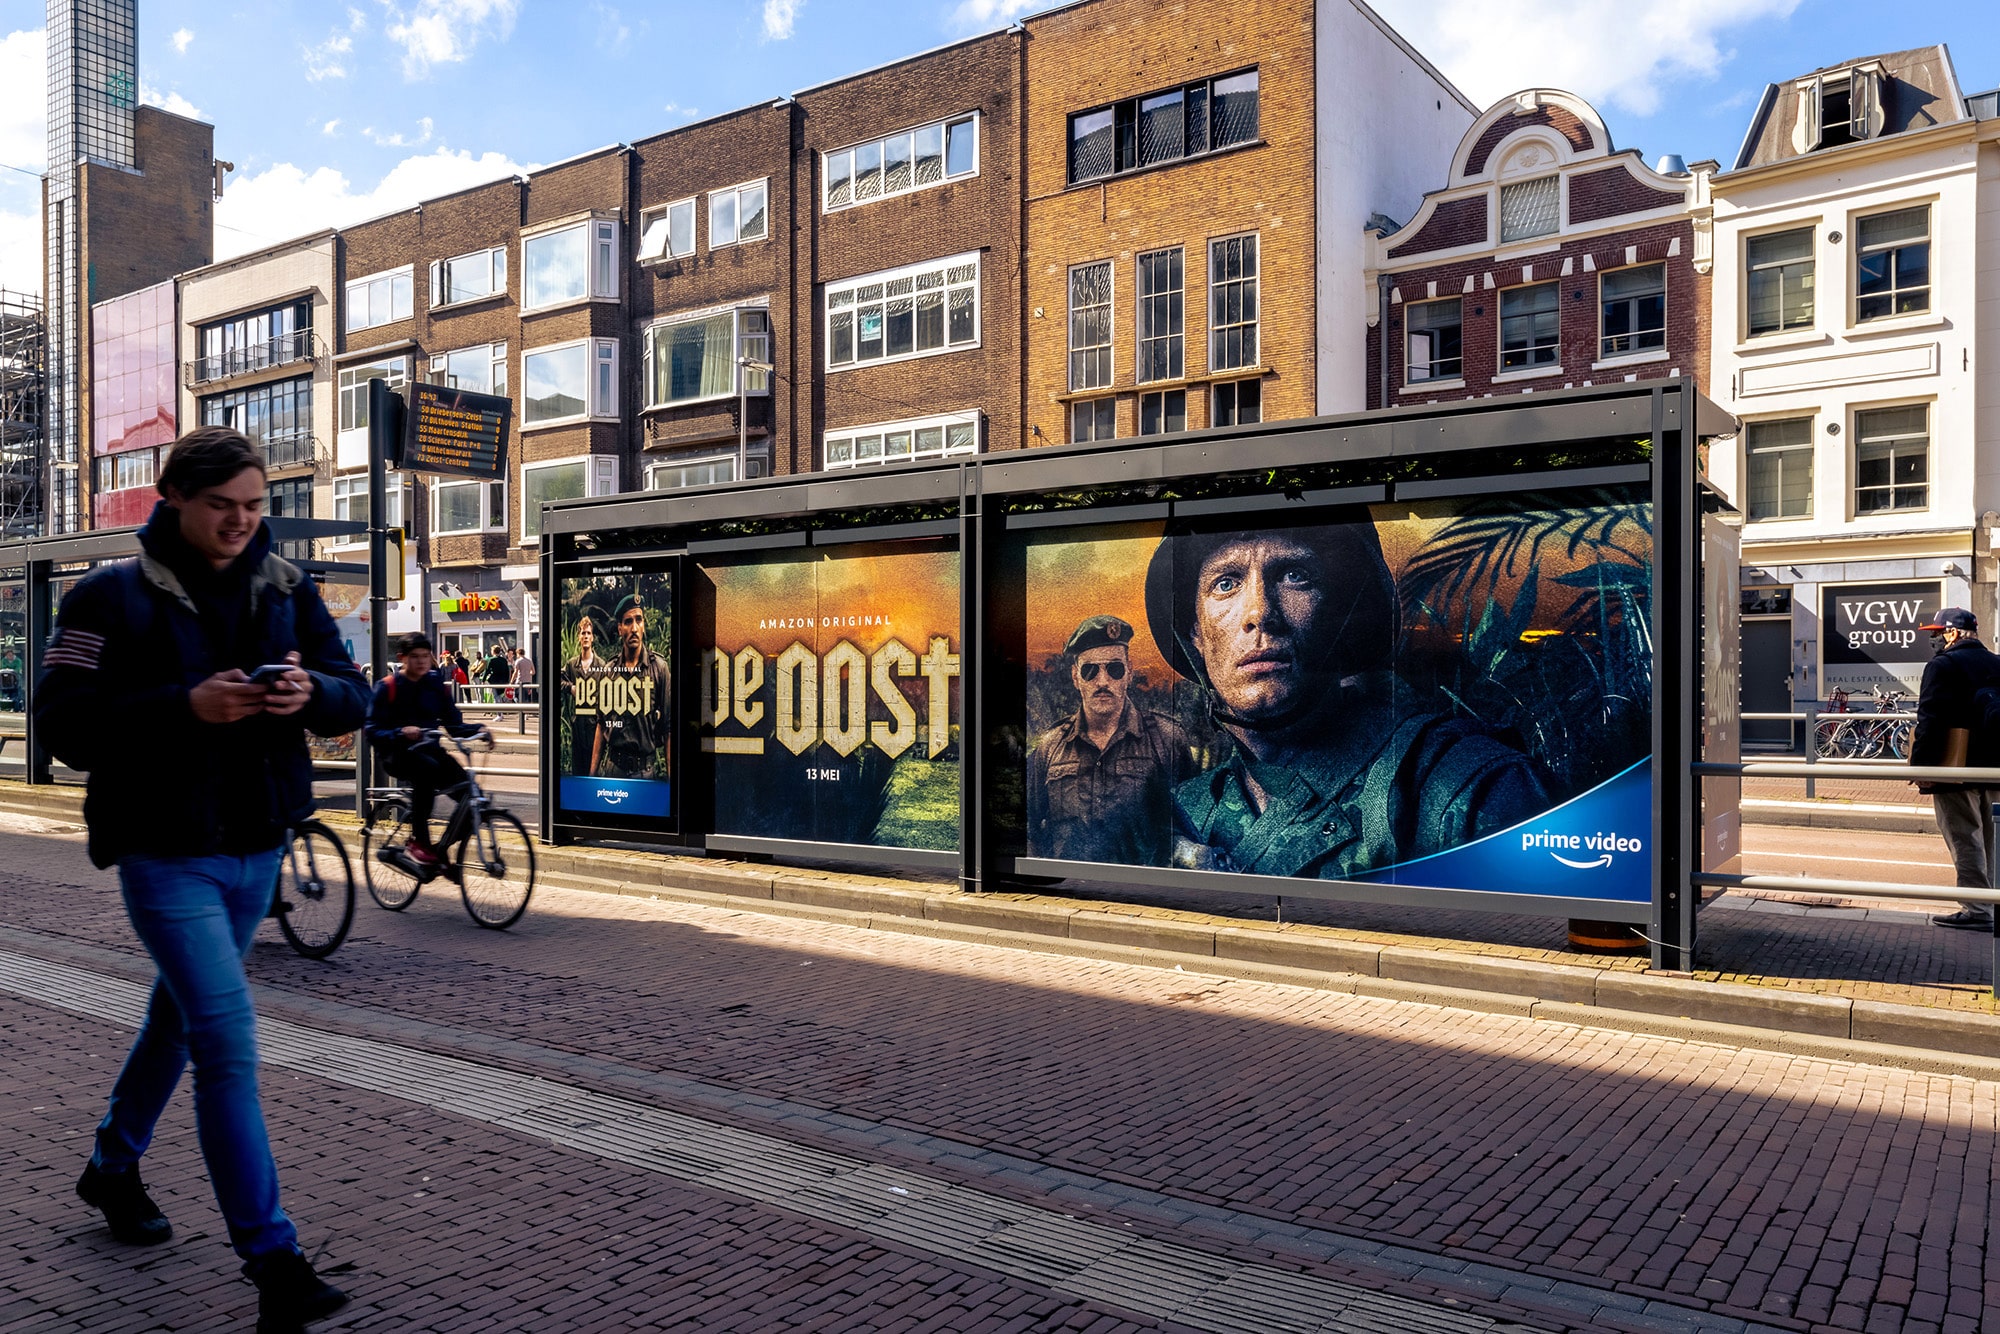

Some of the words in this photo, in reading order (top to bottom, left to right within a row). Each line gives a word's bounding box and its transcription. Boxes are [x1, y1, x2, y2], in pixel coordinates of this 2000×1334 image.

[421, 405, 429, 413] 50
[430, 406, 482, 421] Driebergen-Zeist
[420, 425, 427, 433] 55
[429, 416, 459, 427] Bilthoven
[461, 421, 483, 431] Station
[427, 435, 451, 445] Science
[453, 439, 467, 448] Park
[426, 455, 469, 467] Zeist-Centrum
[1841, 600, 1923, 625] VGW
[760, 617, 814, 630] AMAZON
[822, 614, 891, 628] ORIGINAL
[1848, 629, 1916, 649] group
[1827, 675, 1848, 683] REAL
[1851, 675, 1882, 683] ESTATE
[605, 720, 612, 728] 13
[612, 720, 623, 728] MEI
[806, 768, 817, 780] 13
[820, 769, 840, 781] MEI
[597, 789, 613, 798] prime
[613, 789, 629, 798] video
[1522, 829, 1581, 851] prime
[1584, 831, 1642, 852] video
